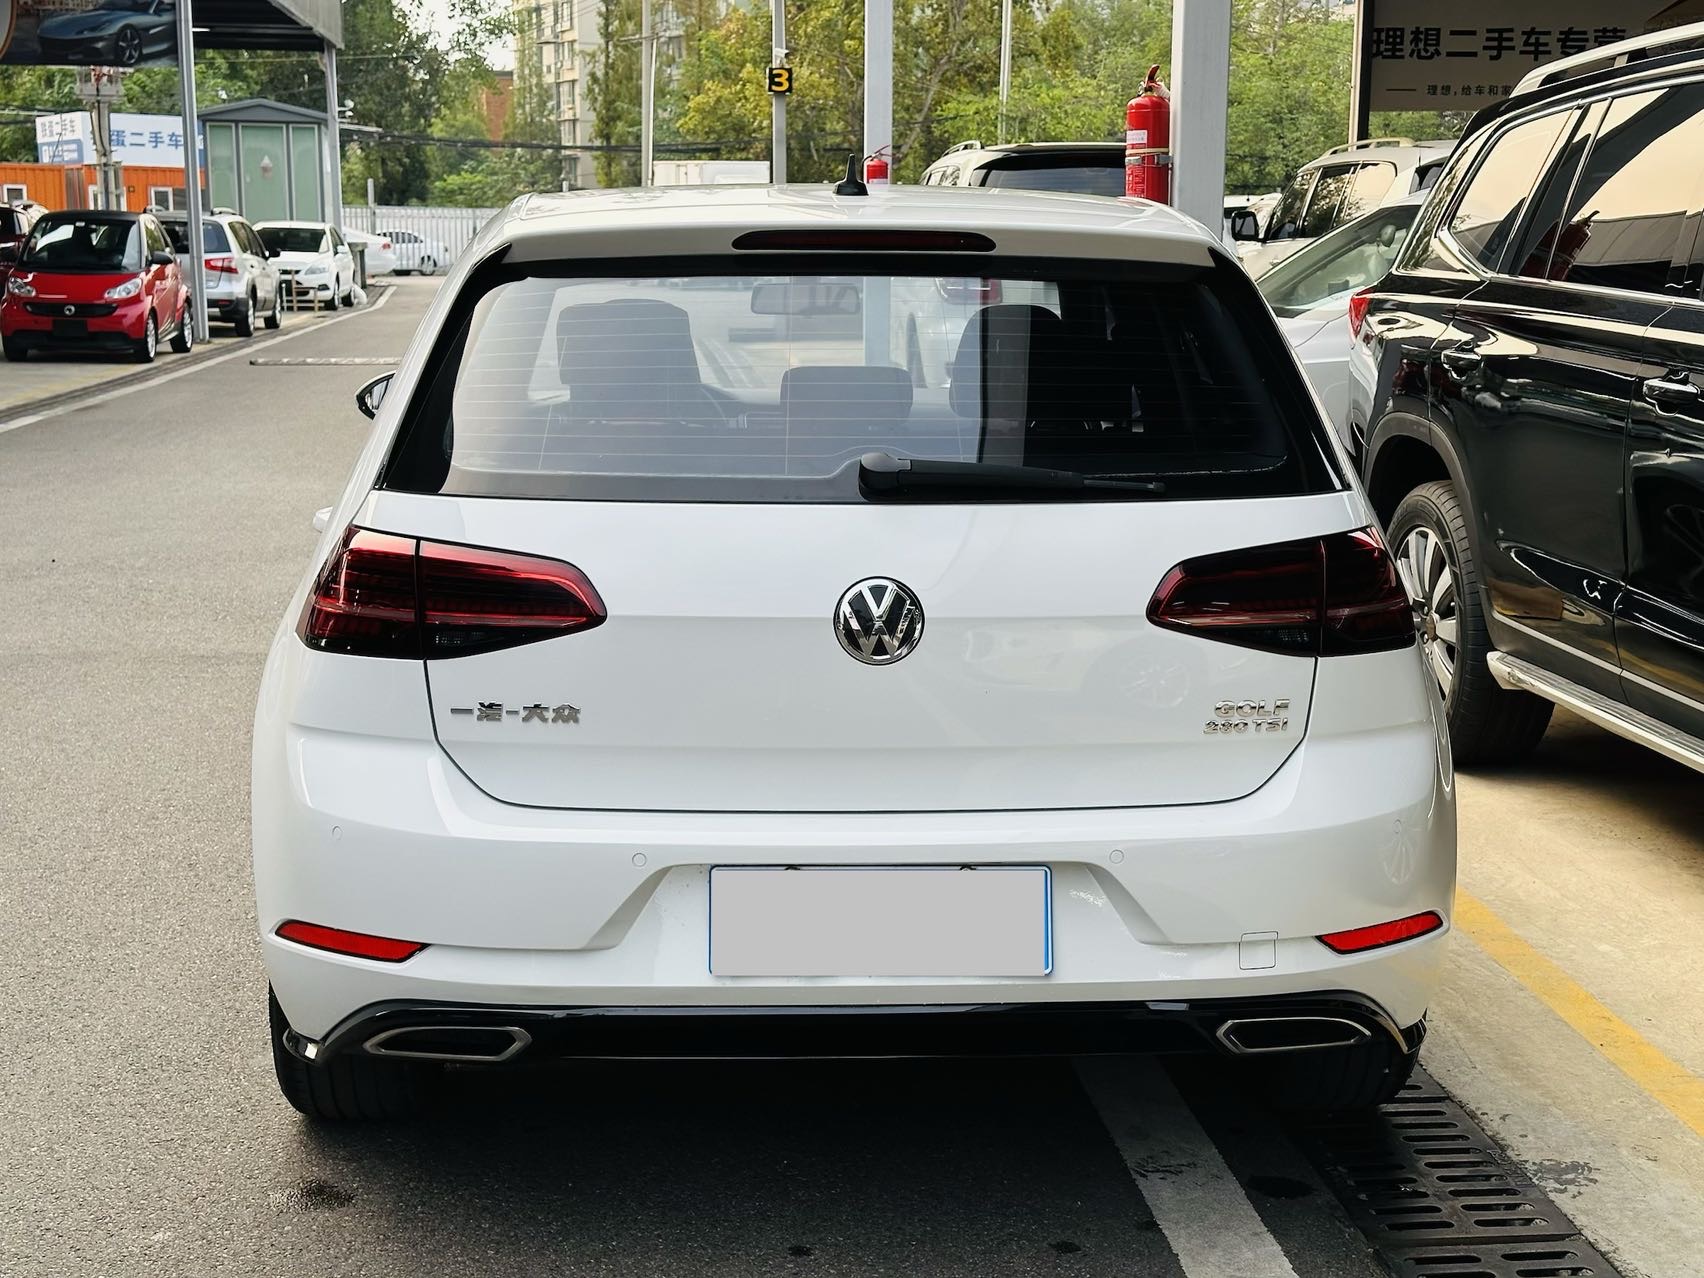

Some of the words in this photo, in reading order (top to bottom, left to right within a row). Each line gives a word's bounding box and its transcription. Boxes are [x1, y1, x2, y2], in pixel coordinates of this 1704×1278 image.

[771, 69, 789, 92] 3
[91, 129, 184, 149] 蛋二手车
[1214, 699, 1290, 718] GOLF
